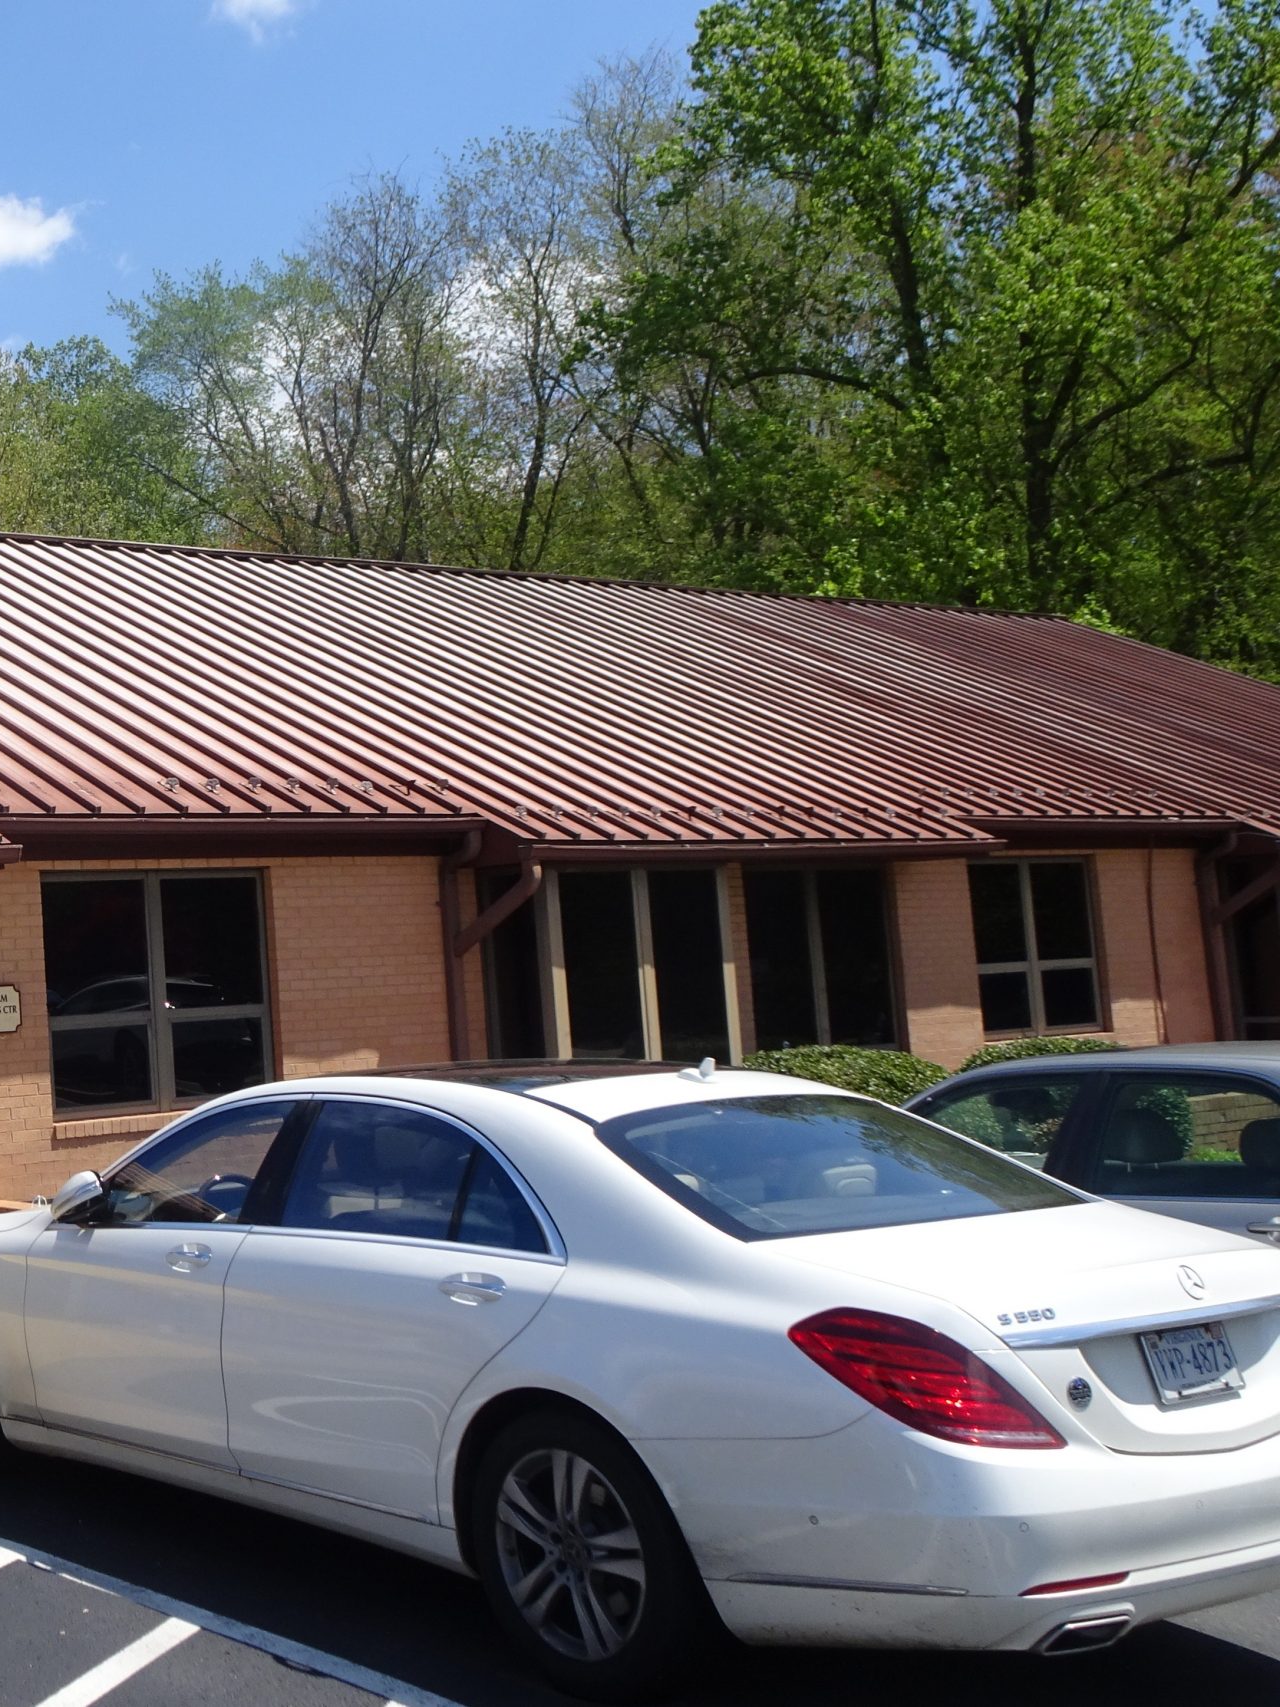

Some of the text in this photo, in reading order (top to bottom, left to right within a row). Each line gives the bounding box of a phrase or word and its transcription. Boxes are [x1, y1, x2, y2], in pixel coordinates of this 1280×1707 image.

[2, 1005, 18, 1014] CTR
[997, 1307, 1056, 1326] S 550
